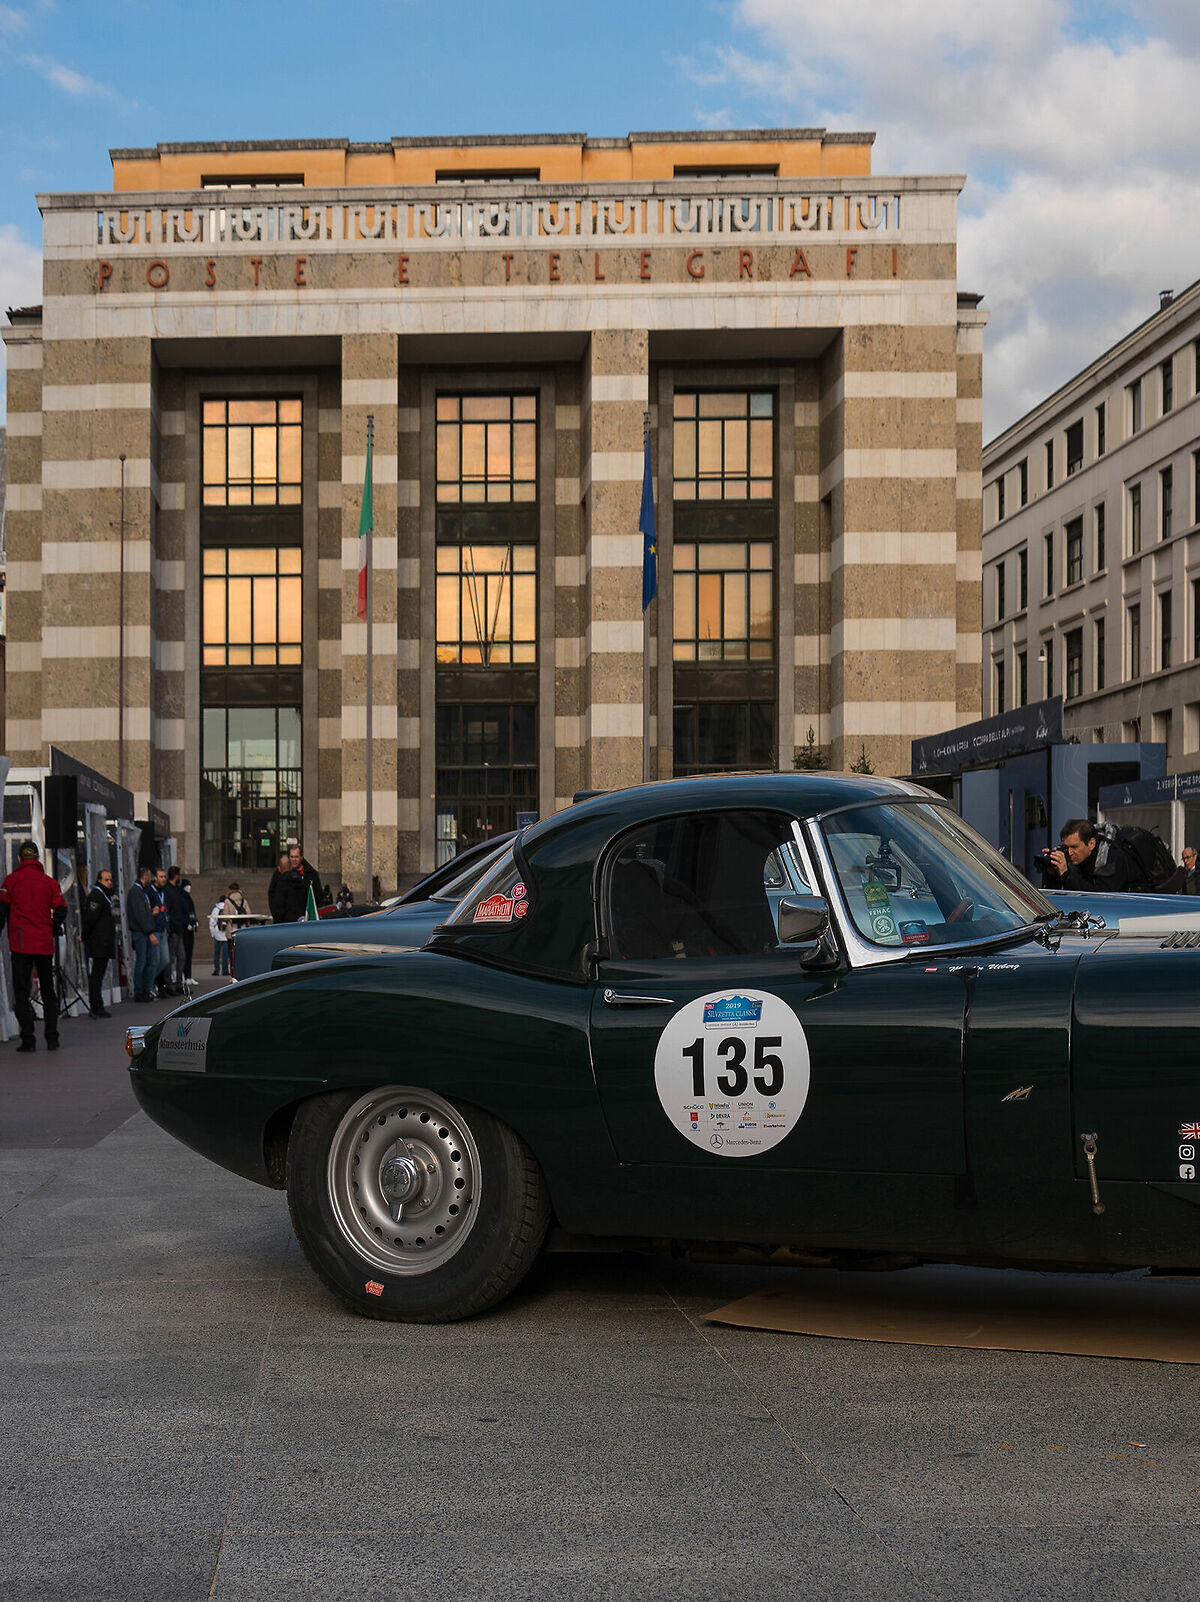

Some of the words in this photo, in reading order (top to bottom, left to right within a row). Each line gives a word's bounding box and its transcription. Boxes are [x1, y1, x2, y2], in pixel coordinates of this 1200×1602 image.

[98, 256, 307, 289] POSTE
[399, 254, 410, 284] E
[502, 247, 898, 281] TELEGRAFI
[478, 901, 511, 916] MARATHON
[869, 907, 891, 916] FEHAC
[707, 1010, 735, 1018] SILVRETTA
[735, 1009, 757, 1017] CLASSIC
[682, 1036, 784, 1097] 135
